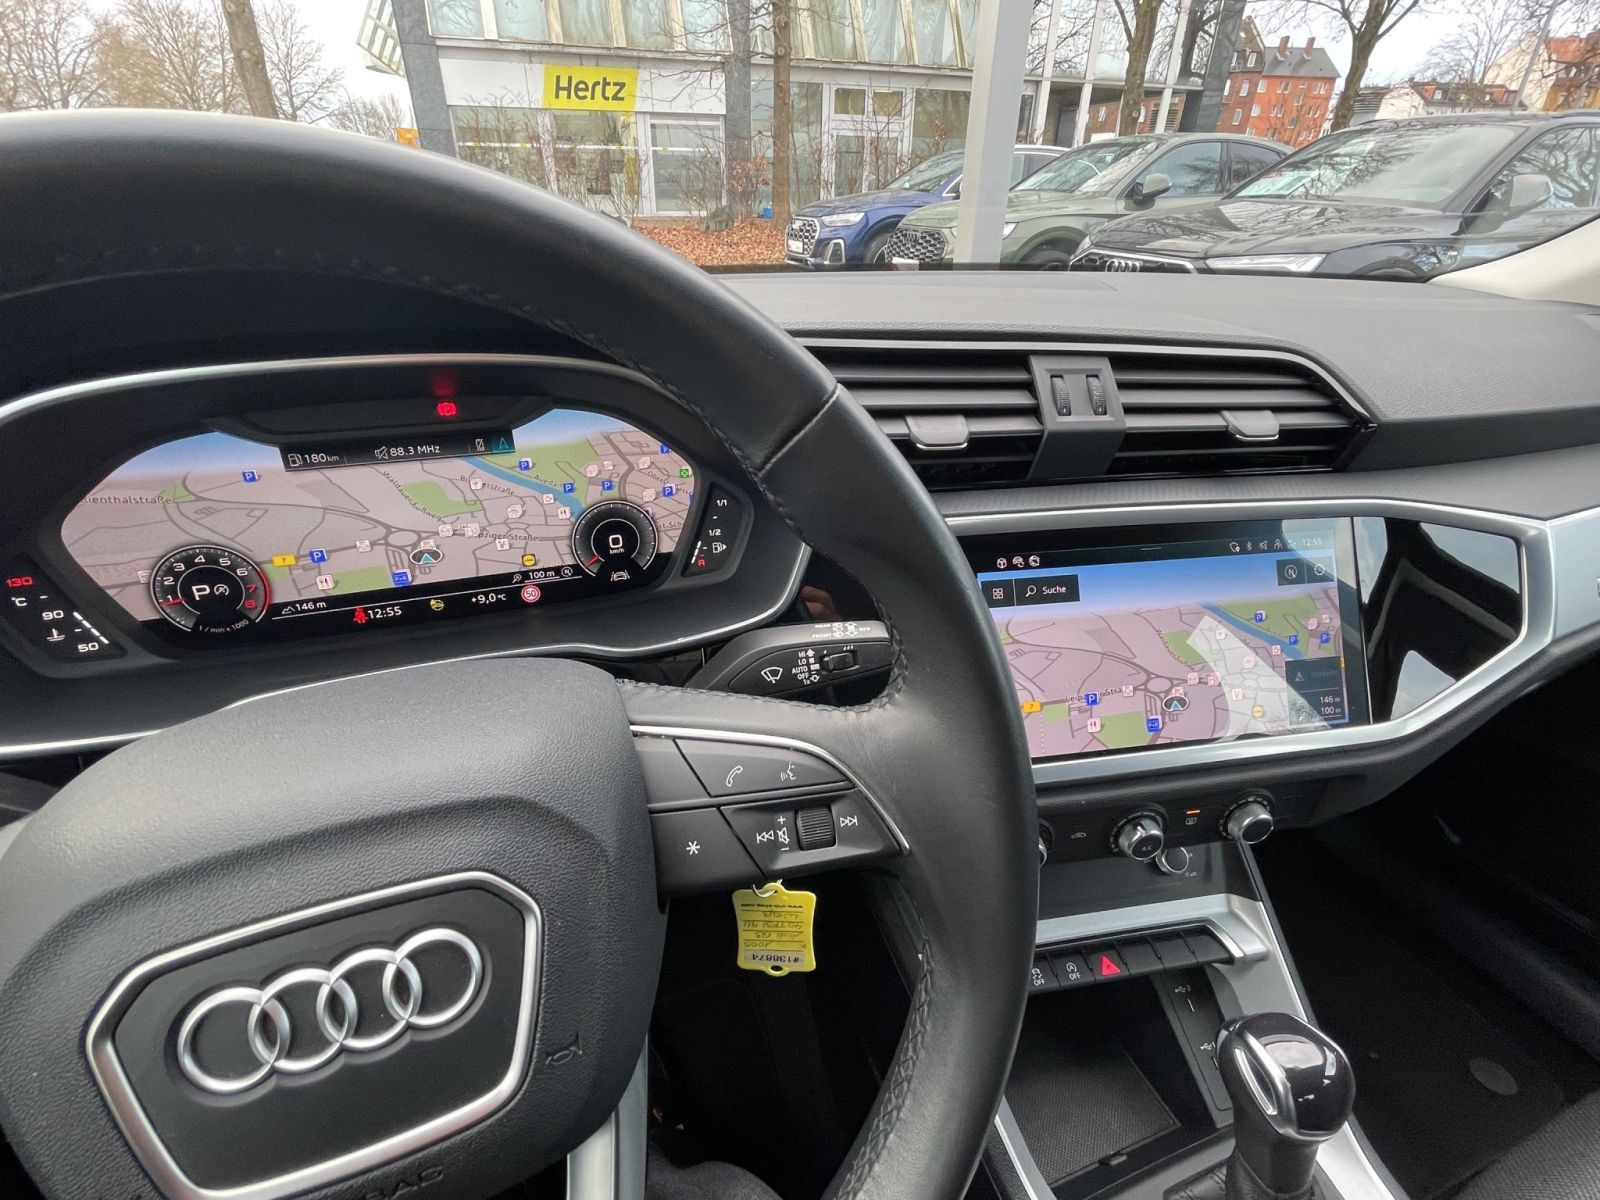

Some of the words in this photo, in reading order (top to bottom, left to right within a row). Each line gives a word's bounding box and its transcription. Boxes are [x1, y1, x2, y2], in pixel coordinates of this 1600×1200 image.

[555, 75, 626, 101] Hertz
[390, 447, 415, 457] 88.3
[417, 445, 440, 454] MHz
[304, 453, 326, 463] 180
[716, 499, 727, 507] 1/1
[708, 528, 721, 536] 1/2
[194, 555, 205, 563] 4
[219, 557, 231, 566] 5
[173, 562, 185, 571] 3
[236, 567, 248, 576] 6
[528, 571, 545, 580] 100
[6, 576, 33, 587] 130
[163, 576, 175, 585] 2
[191, 584, 211, 600] P
[246, 583, 257, 593] 7
[1042, 584, 1066, 596] Suche
[525, 589, 536, 598] 50
[244, 600, 256, 608] 8
[295, 602, 315, 611] 146
[42, 610, 64, 620] 90
[367, 605, 402, 619] 12:55
[231, 619, 249, 630] 1000
[78, 642, 99, 652] 50
[791, 666, 808, 674] AUTO
[797, 672, 809, 680] OFF
[1320, 706, 1335, 714] 100
[1069, 972, 1081, 980] OFF
